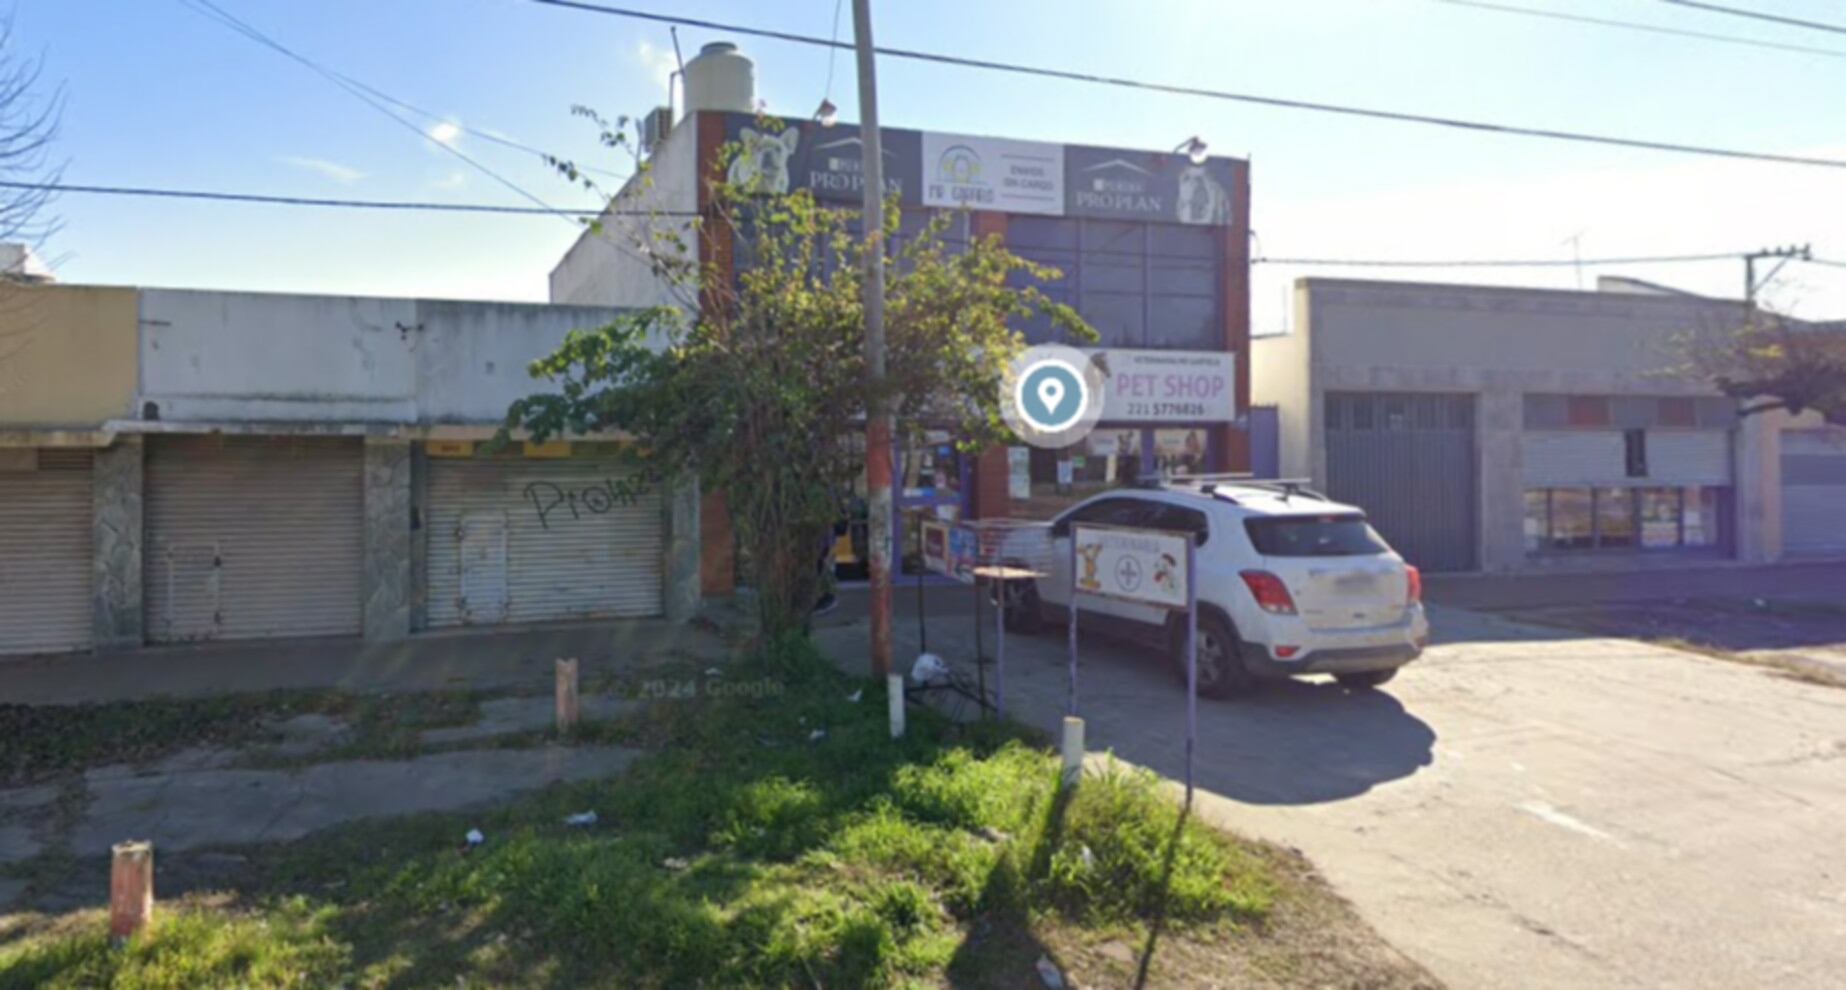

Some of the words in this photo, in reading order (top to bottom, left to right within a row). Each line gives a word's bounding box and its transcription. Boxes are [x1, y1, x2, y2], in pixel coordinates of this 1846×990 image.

[1116, 373, 1158, 397] PET
[1163, 375, 1225, 400] SHOP
[1127, 402, 1149, 416] 221
